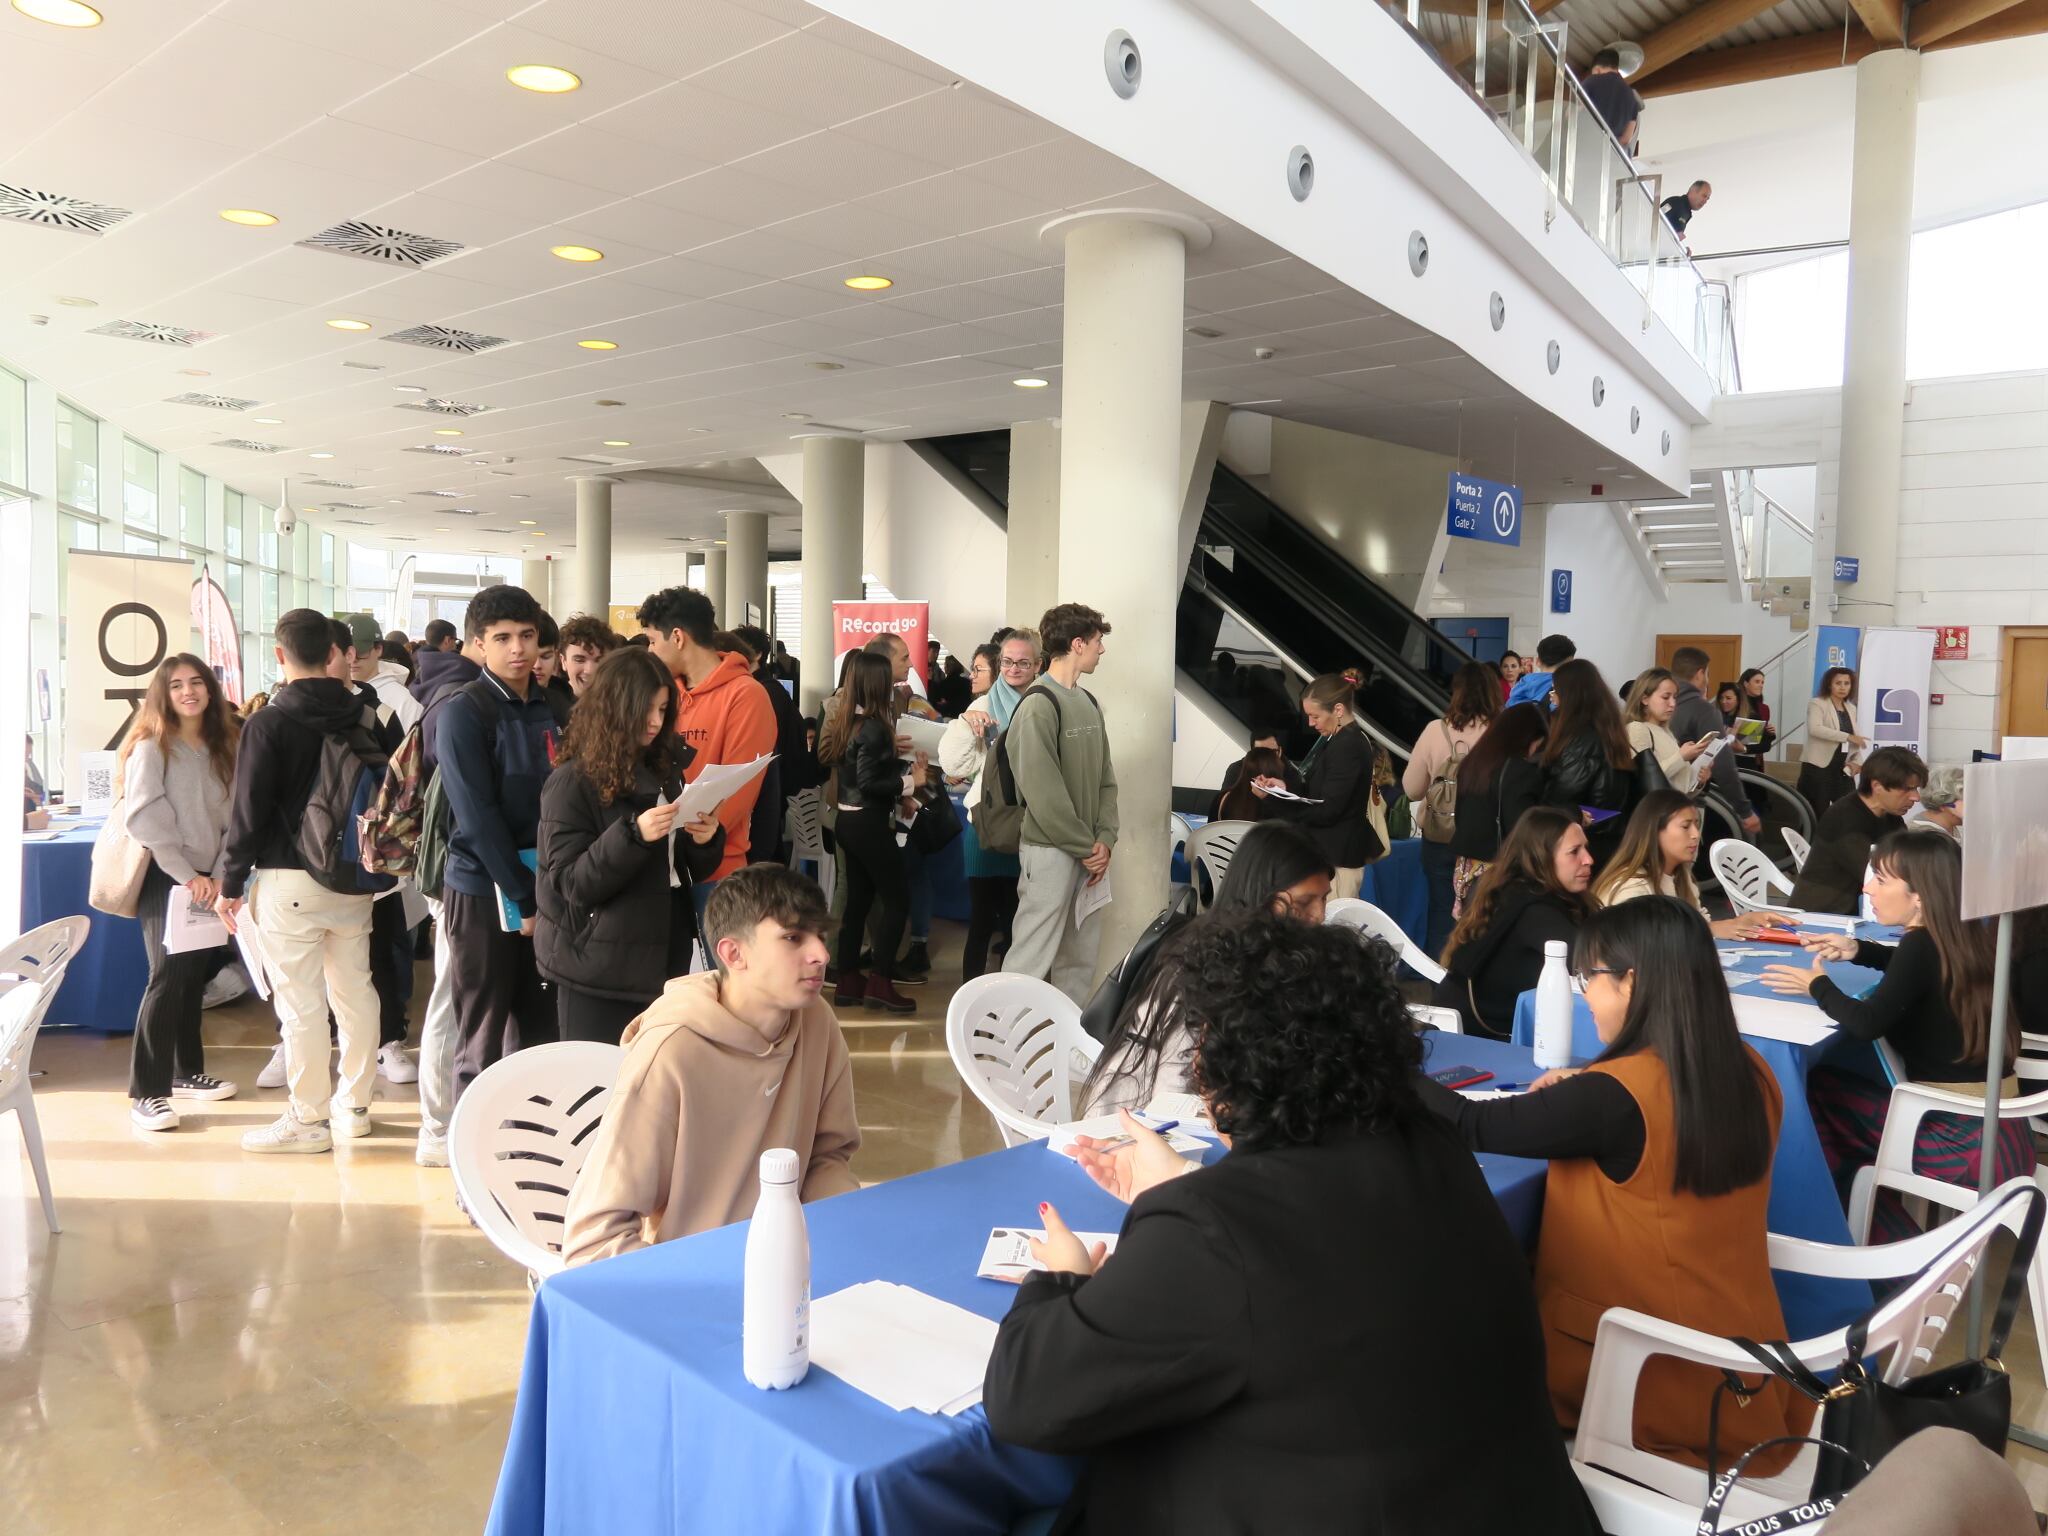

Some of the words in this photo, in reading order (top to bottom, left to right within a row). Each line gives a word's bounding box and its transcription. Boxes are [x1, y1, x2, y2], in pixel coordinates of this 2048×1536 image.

[1456, 482, 1476, 496] Porta
[1477, 486, 1482, 497] 2
[1455, 499, 1475, 513] Puerta
[1476, 503, 1480, 514] 2
[1454, 516, 1470, 529] Gate
[1470, 519, 1475, 529] 2
[1707, 1468, 1738, 1508] TOUS
[1735, 1516, 1781, 1536] TOUS
[1789, 1499, 1836, 1523] TOUS
